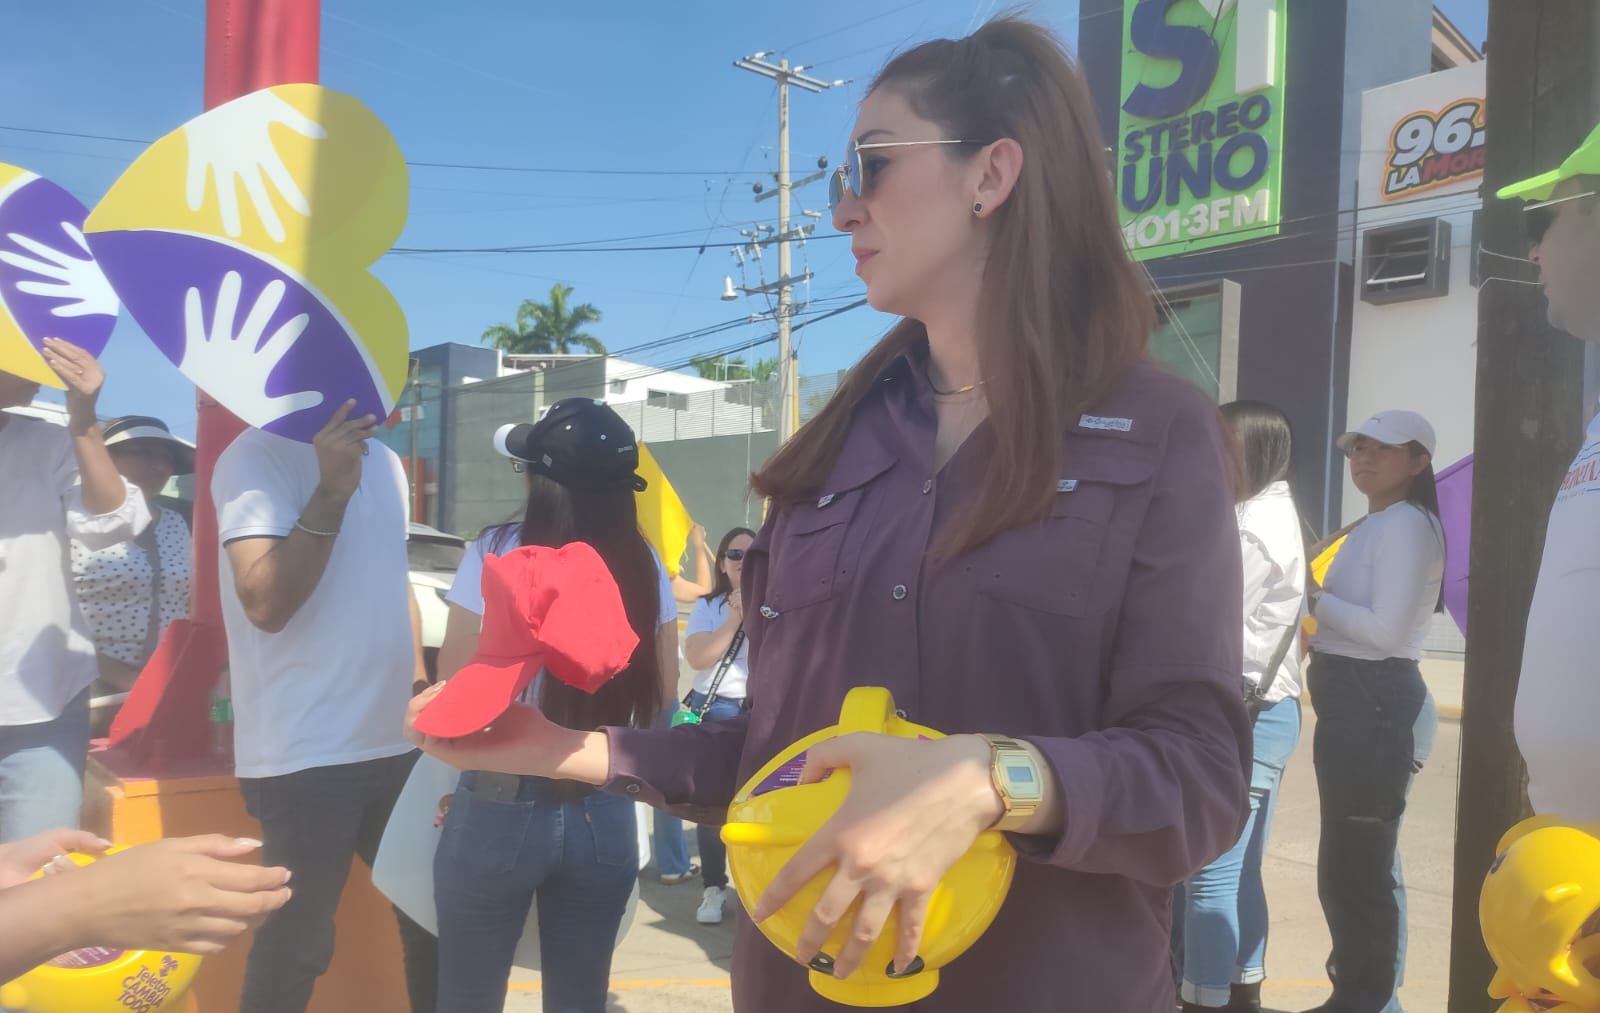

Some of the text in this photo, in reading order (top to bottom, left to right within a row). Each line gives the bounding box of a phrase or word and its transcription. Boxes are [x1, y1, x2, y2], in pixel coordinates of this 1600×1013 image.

[1123, 94, 1272, 162] STEREO
[1121, 131, 1270, 214] UNO
[1386, 165, 1421, 193] LA
[121, 975, 164, 1008] CAMBIA
